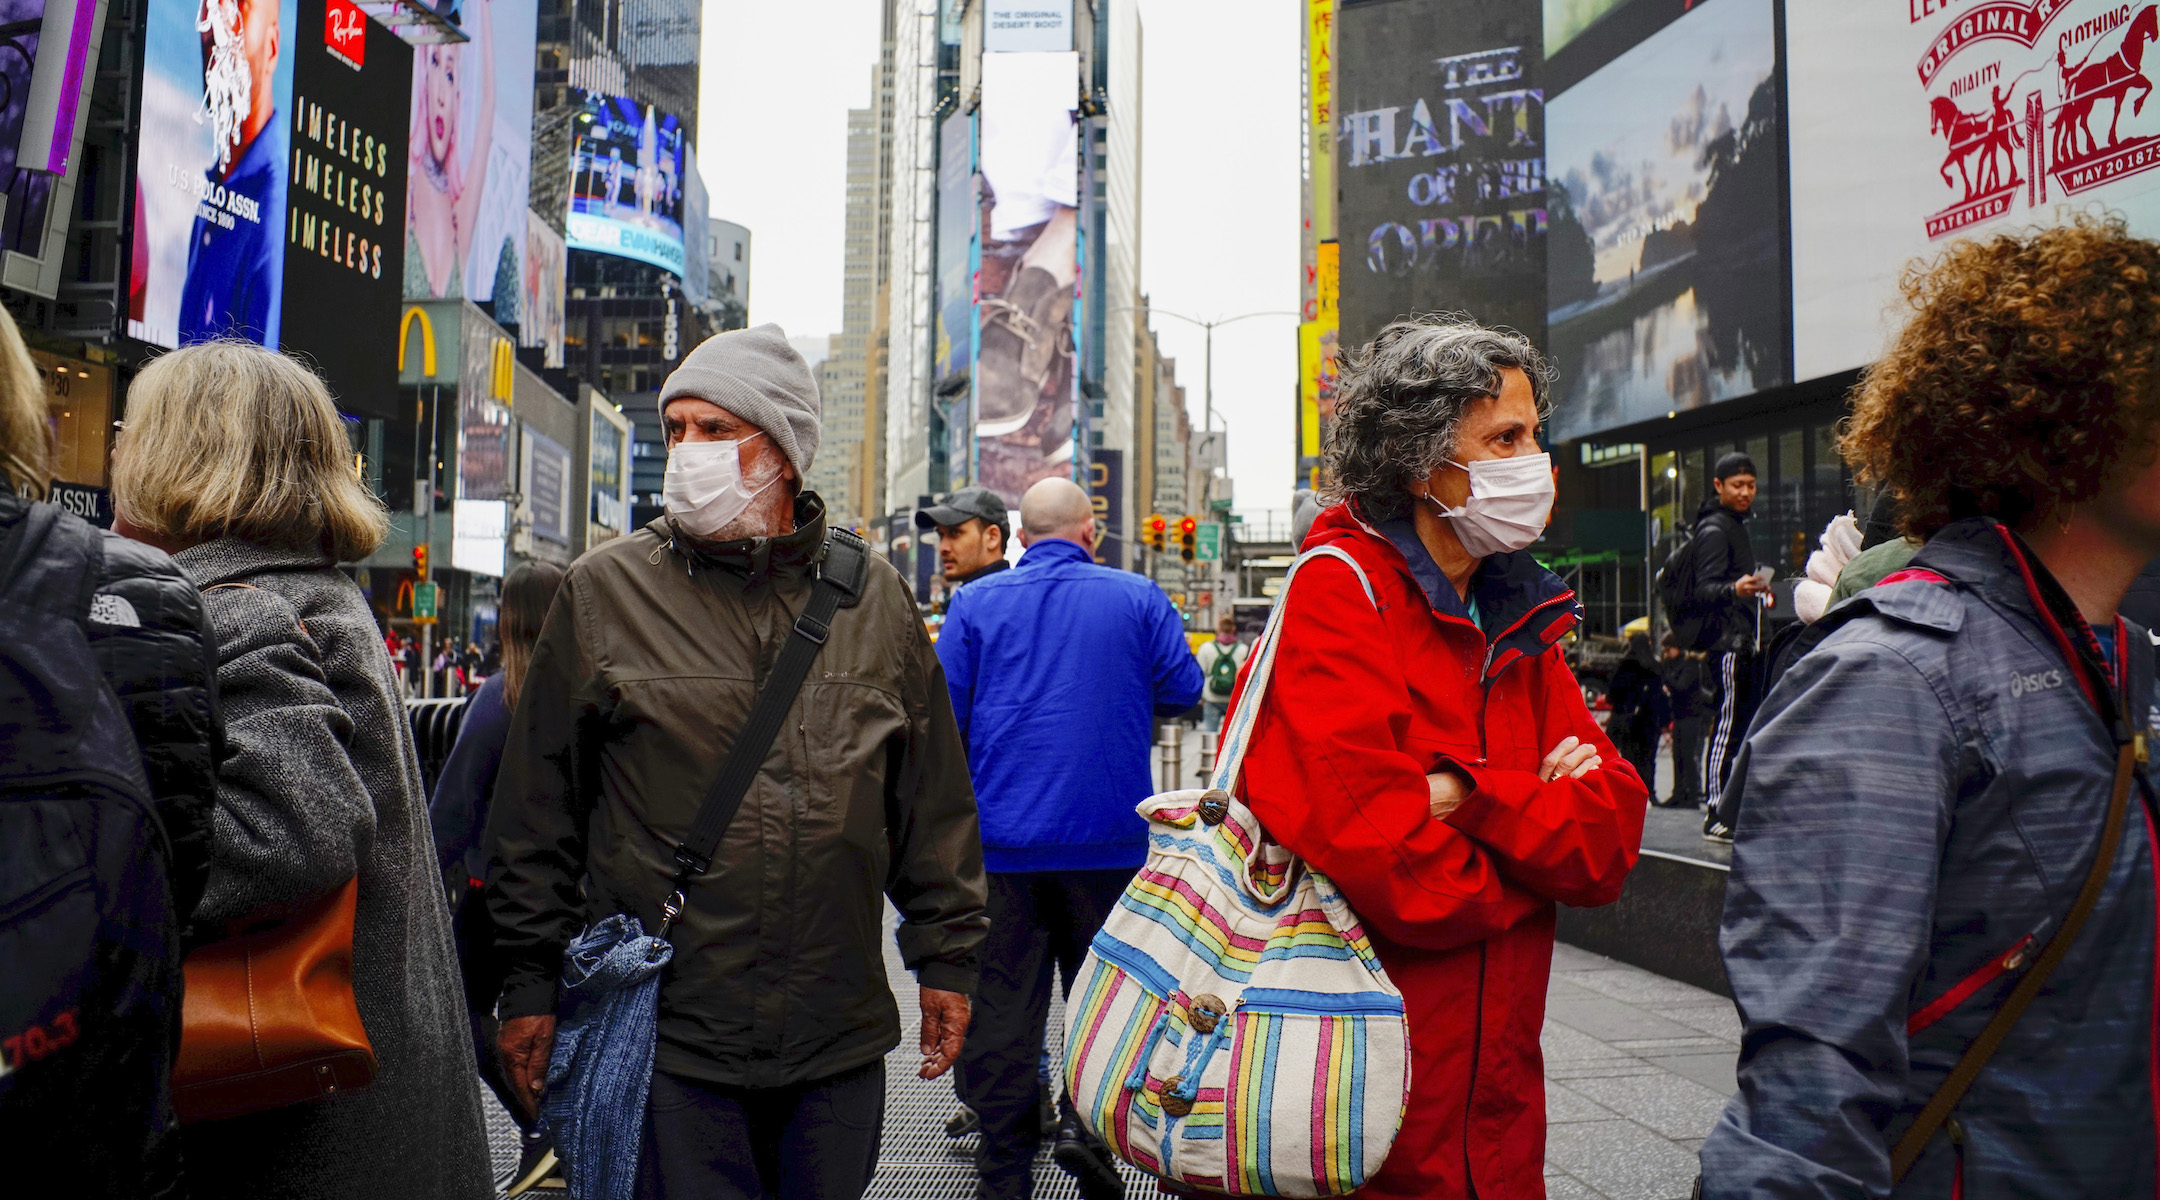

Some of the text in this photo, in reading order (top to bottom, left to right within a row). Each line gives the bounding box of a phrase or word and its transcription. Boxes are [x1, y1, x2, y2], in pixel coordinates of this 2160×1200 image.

[993, 11, 1010, 19] THE
[1034, 20, 1062, 29] BOOT
[1910, 0, 1958, 24] LE
[1921, 9, 2030, 78] ORIGINAL
[1432, 46, 1523, 89] THE
[296, 95, 387, 178] IMELESS
[294, 147, 385, 226] IMELESS
[2072, 144, 2160, 187] MAY 20 1873
[168, 164, 261, 225] U.S. POLO ASSN.
[195, 202, 218, 224] SINCE
[1929, 199, 2003, 235] PATENTED
[291, 206, 383, 280] IMELESS
[663, 298, 678, 361] 1500
[51, 487, 100, 518] ASSN.
[4, 1009, 79, 1068] 70.3
